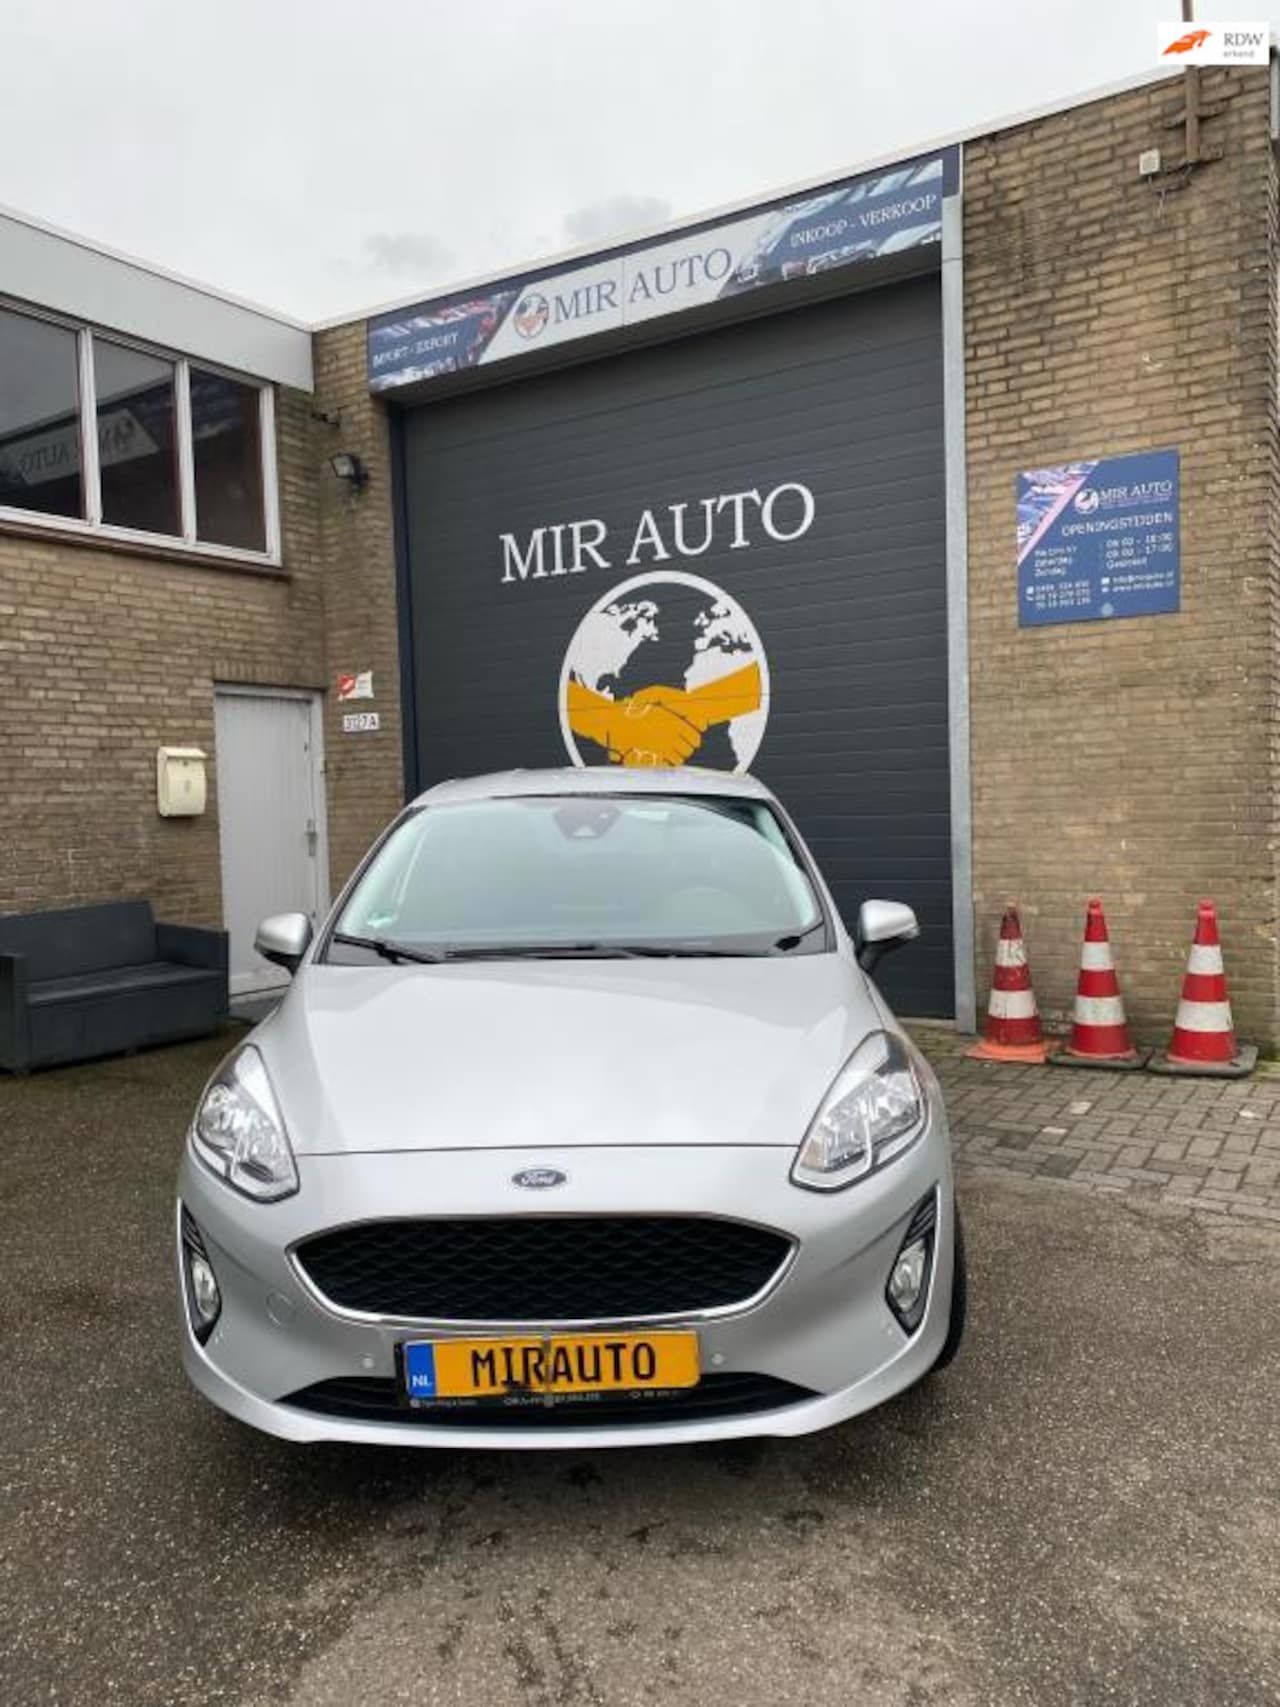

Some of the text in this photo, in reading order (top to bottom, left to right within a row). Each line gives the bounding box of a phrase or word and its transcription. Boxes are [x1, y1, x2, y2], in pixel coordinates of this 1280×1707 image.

[790, 219, 848, 247] INKOOP
[859, 194, 937, 228] VERKOOP
[554, 248, 732, 324] MIR AUTO
[1101, 479, 1173, 500] MIR AUTO
[499, 482, 816, 583] MIR AUTO
[521, 1171, 556, 1185] Ford
[411, 1374, 432, 1387] NL
[470, 1342, 657, 1388] MIRAUTO
